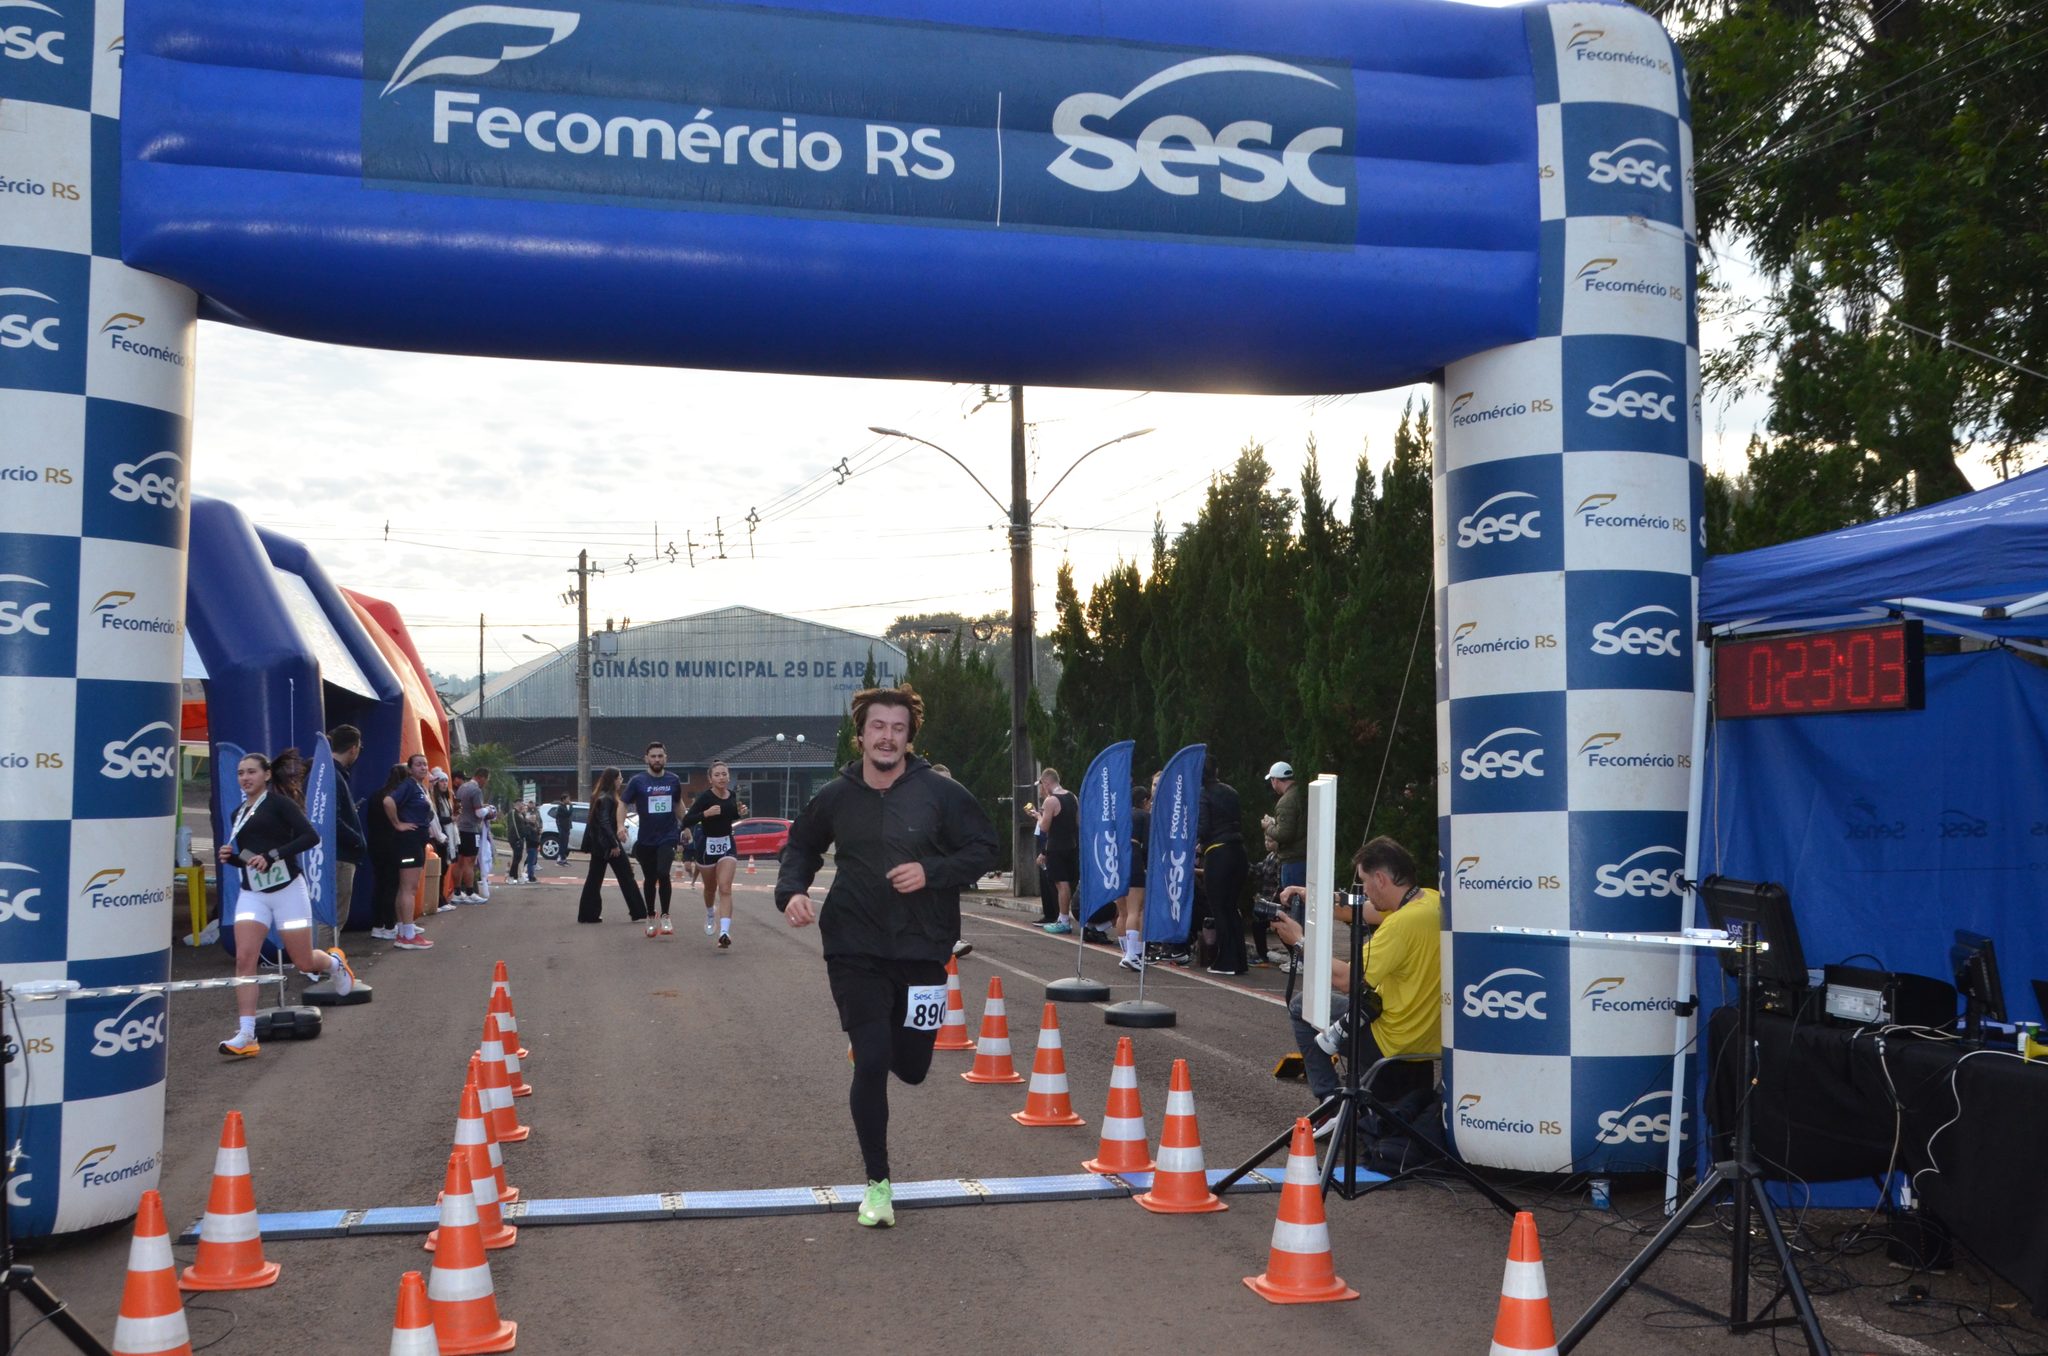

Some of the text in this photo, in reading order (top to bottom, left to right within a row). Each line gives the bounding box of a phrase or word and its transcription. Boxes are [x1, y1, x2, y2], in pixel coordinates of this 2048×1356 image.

[1576, 48, 1656, 70] Fecomércio
[432, 90, 956, 181] Fecomércio RS
[1046, 91, 1346, 206] Sesc
[1587, 150, 1673, 193] Sesc
[52, 181, 80, 200] RS
[1585, 277, 1682, 300] Fecomércio RS
[1453, 399, 1553, 428] Fecomércio RS
[1586, 385, 1676, 422] Sesc
[45, 467, 73, 484] RS
[109, 463, 185, 511] Sesc
[1457, 510, 1541, 548] Sesc
[1585, 513, 1670, 531] Fecomércio
[1672, 518, 1687, 532] RS
[102, 614, 175, 634] Fecomércio
[1456, 636, 1530, 657] Fecomércio
[1535, 634, 1557, 649] RS
[1590, 621, 1681, 657] Sesc
[592, 657, 894, 677] GINÁSIO MUNICIPAL 29 DE ABIL
[36, 752, 64, 769] RS
[100, 740, 175, 779] Sesc
[1460, 747, 1544, 781] Sesc
[1588, 752, 1691, 768] Fecomércio RS
[655, 802, 666, 812] 65
[1101, 766, 1110, 822] Fecomércio
[1169, 774, 1183, 839] Fecomércio
[709, 843, 728, 854] 936
[1104, 830, 1120, 890] Sesc
[1169, 850, 1186, 922] Sesc
[1459, 875, 1533, 890] Fecomércio
[1538, 876, 1560, 890] RS
[1594, 864, 1685, 897] Sesc
[92, 889, 165, 908] Fecomércio
[1462, 983, 1547, 1020] Sesc
[1592, 997, 1678, 1011] Fecomércio
[26, 1037, 54, 1054] RS
[90, 1012, 165, 1057] Sesc
[1460, 1113, 1534, 1134] Fecomércio
[1539, 1121, 1561, 1135] RS
[83, 1157, 155, 1188] Fecomércio
